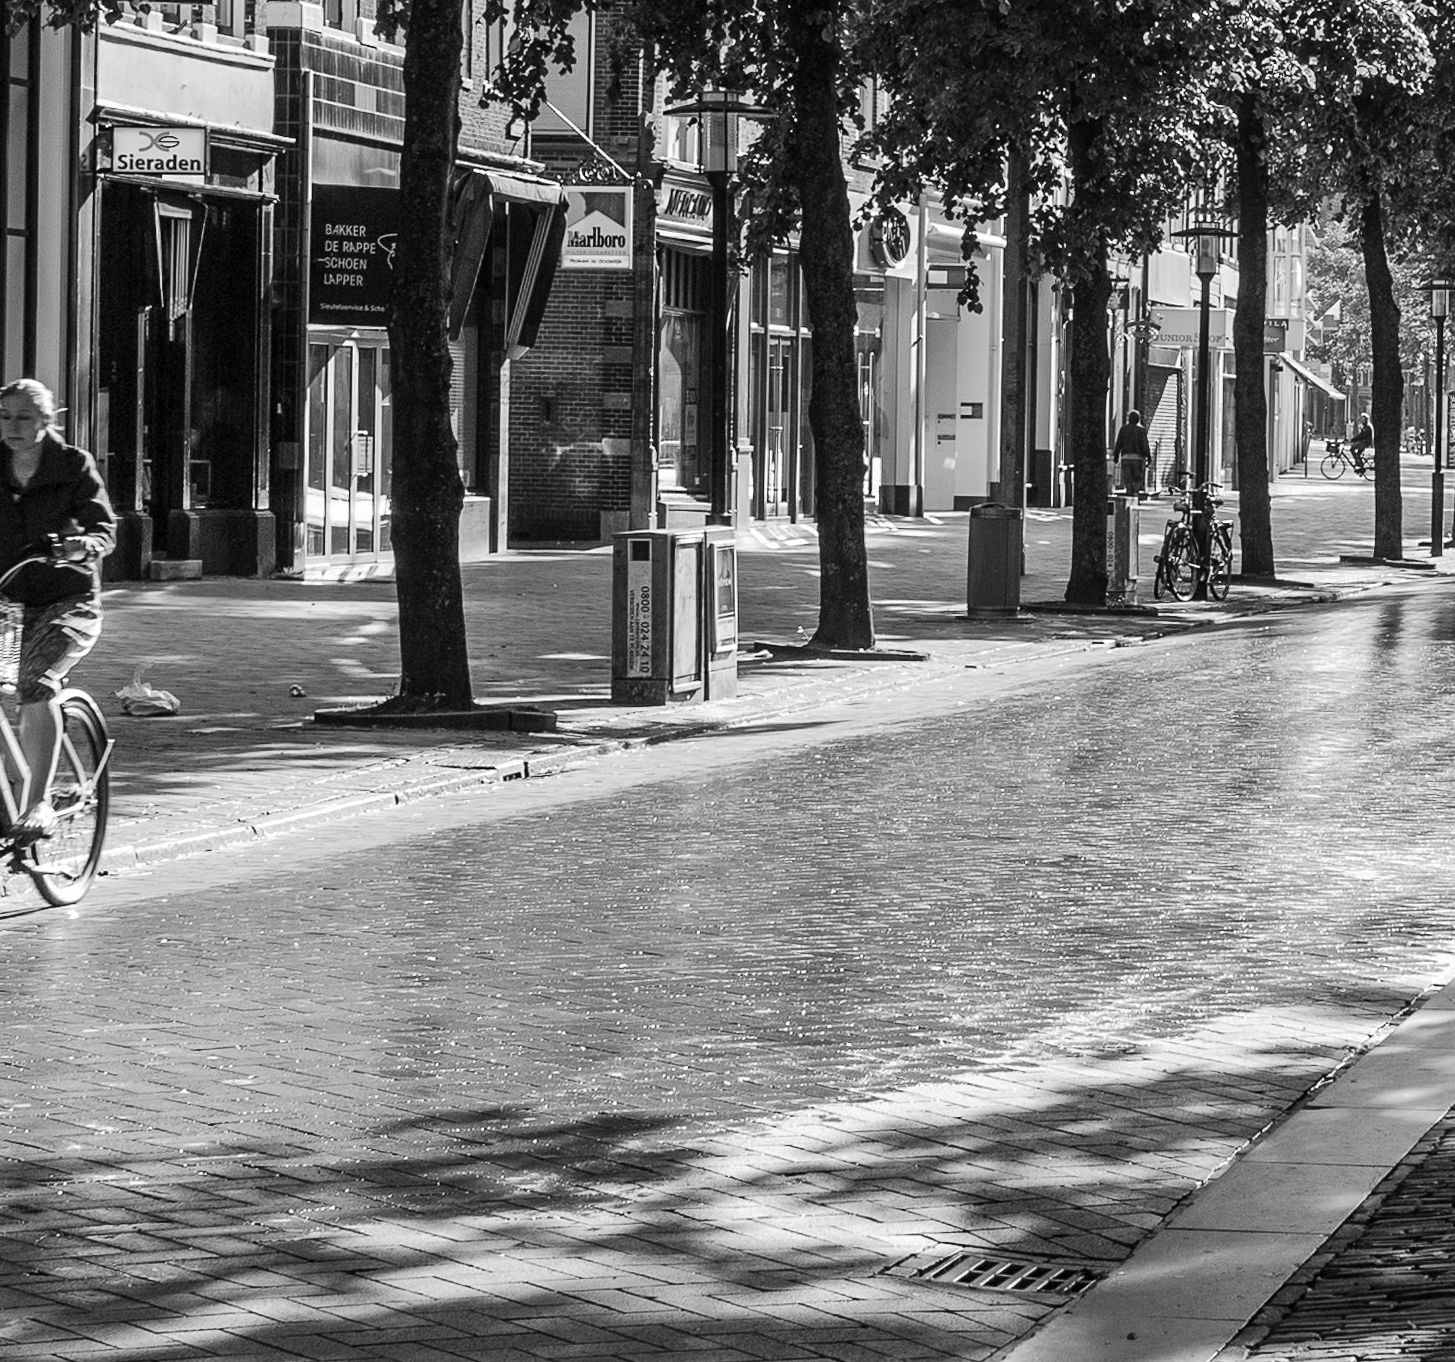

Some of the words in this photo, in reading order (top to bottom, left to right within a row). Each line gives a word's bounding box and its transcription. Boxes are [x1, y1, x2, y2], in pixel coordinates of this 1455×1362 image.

[117, 154, 202, 171] Sieraden
[325, 224, 367, 237] BAKKER
[567, 227, 626, 248] Marlboro
[324, 241, 339, 252] DE
[343, 242, 376, 254] RAPPE
[325, 257, 367, 270] SCHOEN
[324, 274, 364, 286] LAPPER
[1194, 333, 1226, 344] SOP
[641, 586, 650, 613] 0800
[641, 621, 650, 640] 024
[641, 644, 650, 657] 24
[641, 661, 650, 673] 10
